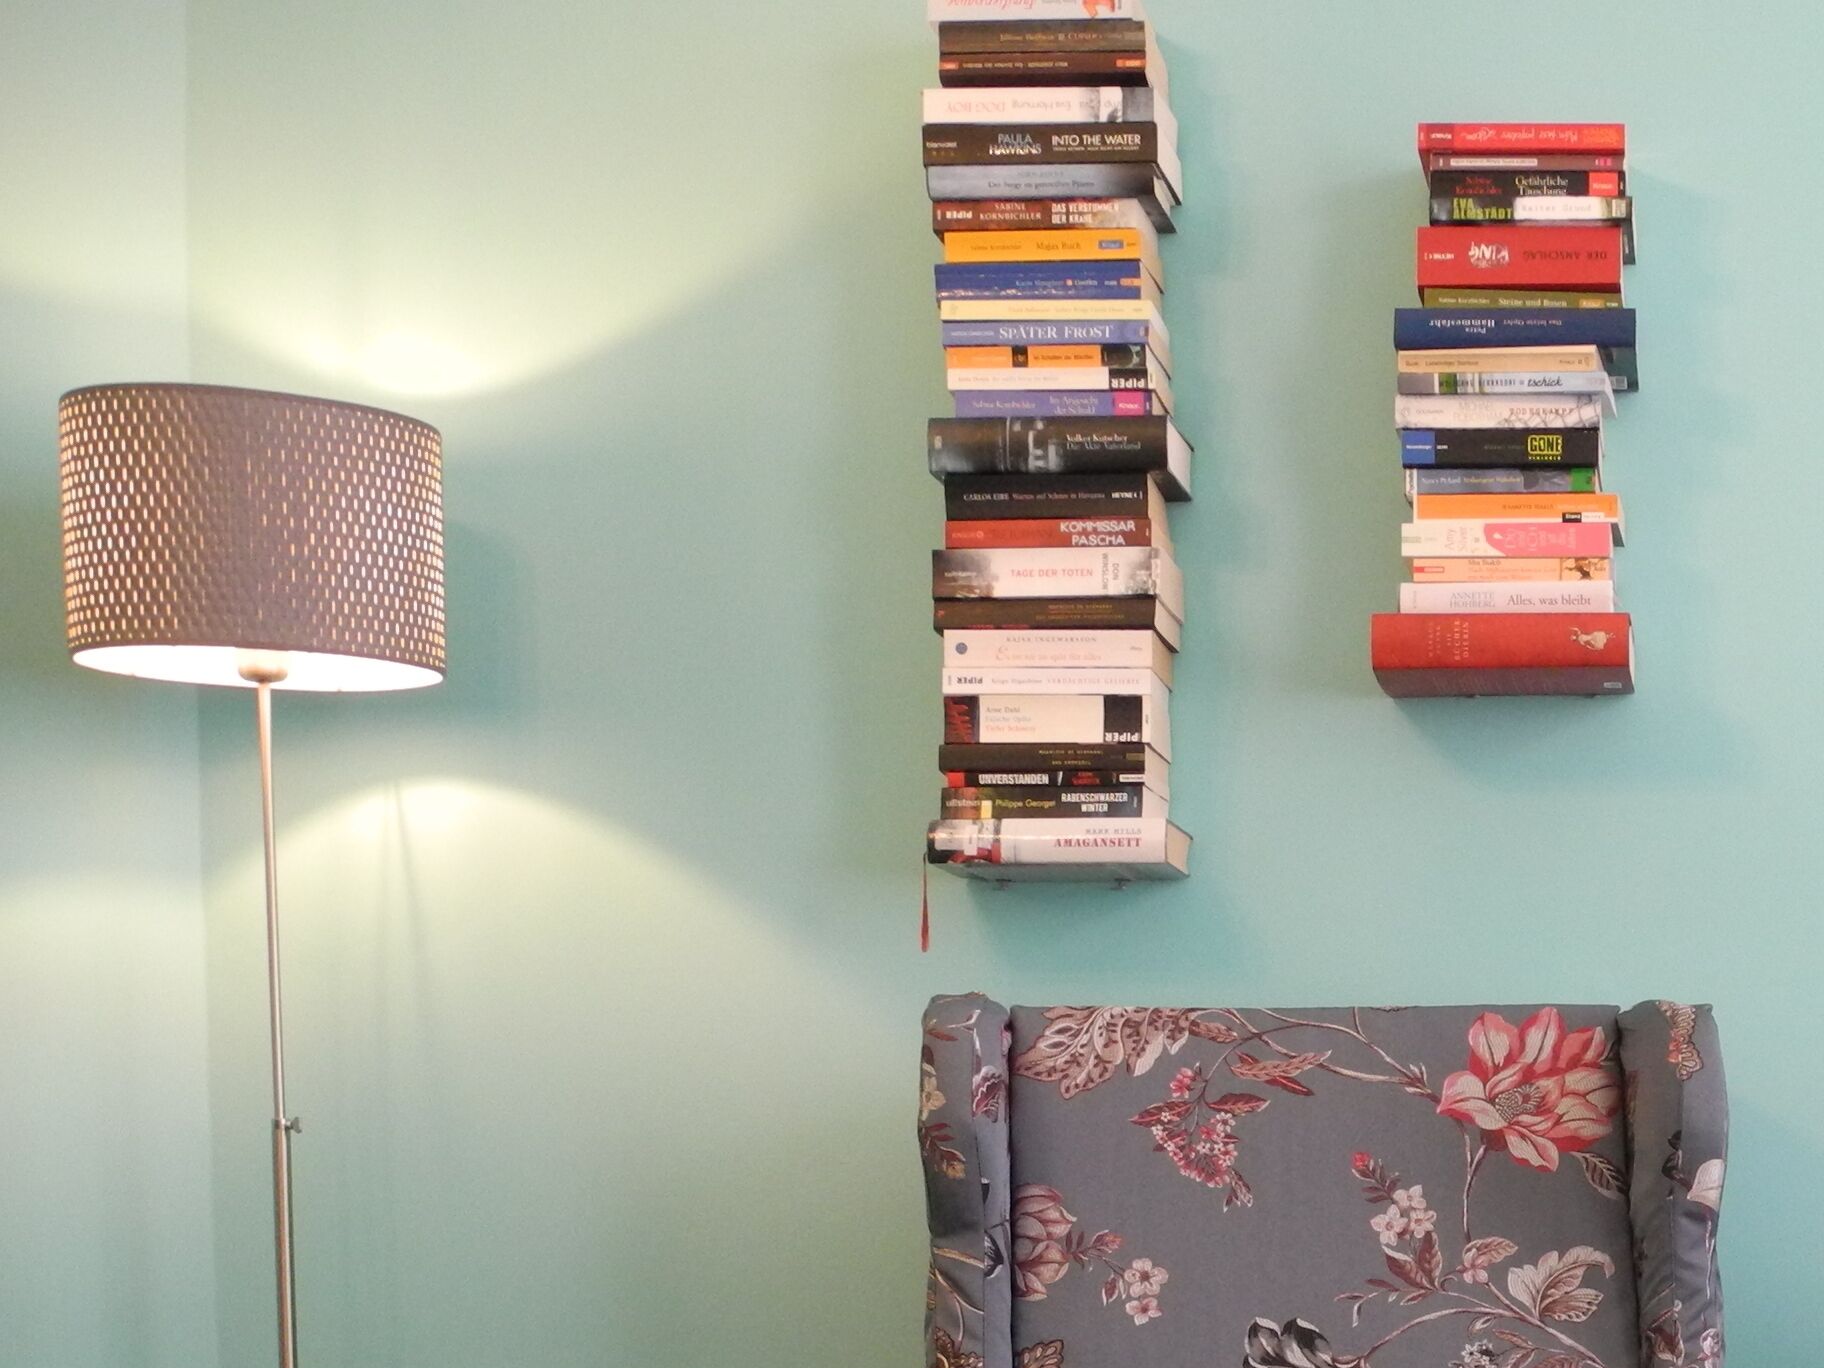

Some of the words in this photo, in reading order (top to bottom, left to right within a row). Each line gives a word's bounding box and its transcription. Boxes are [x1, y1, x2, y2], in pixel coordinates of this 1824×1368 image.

[998, 133, 1033, 145] PAULA
[1051, 135, 1079, 146] INTO
[1082, 135, 1101, 146] THE
[1104, 134, 1142, 146] WATER
[989, 144, 1042, 155] HAWKINS
[1514, 176, 1568, 188] Gefährliche
[995, 202, 1027, 211] SABINE
[1051, 203, 1067, 213] DAS
[1452, 197, 1475, 210] EVA
[979, 211, 1042, 221] KORNBICHLER
[1051, 213, 1067, 224] DER
[1468, 241, 1510, 262] KING
[1522, 251, 1577, 260] ANSCHLAG
[1584, 251, 1608, 260] DER
[1525, 298, 1541, 308] und
[1428, 319, 1495, 329] Hammesfahr
[999, 325, 1058, 340] SPÄTER
[1064, 325, 1112, 340] FROST
[1465, 327, 1487, 335] Petra
[1111, 379, 1145, 390] PIPER
[1527, 376, 1565, 388] tschick
[1529, 436, 1562, 454] GONE
[1060, 521, 1136, 532] KOMMISSAR
[1071, 534, 1127, 546] PASCHA
[1444, 529, 1457, 551] Amy
[1010, 569, 1035, 578] TAGE
[1038, 568, 1058, 578] DER
[1061, 568, 1094, 577] TOTEN
[1111, 563, 1120, 581] DON
[1450, 592, 1495, 600] ANNETTE
[1507, 594, 1536, 607] Alles,
[1538, 597, 1559, 606] was
[1561, 594, 1592, 606] bleibt
[1449, 600, 1496, 609] HOHBERG
[956, 676, 984, 684] PIPER
[1105, 732, 1140, 743] PIPER
[978, 773, 1050, 785] UNVERSTANDEN
[995, 798, 1024, 809] Philippe
[1061, 793, 1129, 803] RABENSCHWARZER
[1081, 803, 1109, 813] WINTER
[1053, 838, 1142, 848] AMAGANSETT
